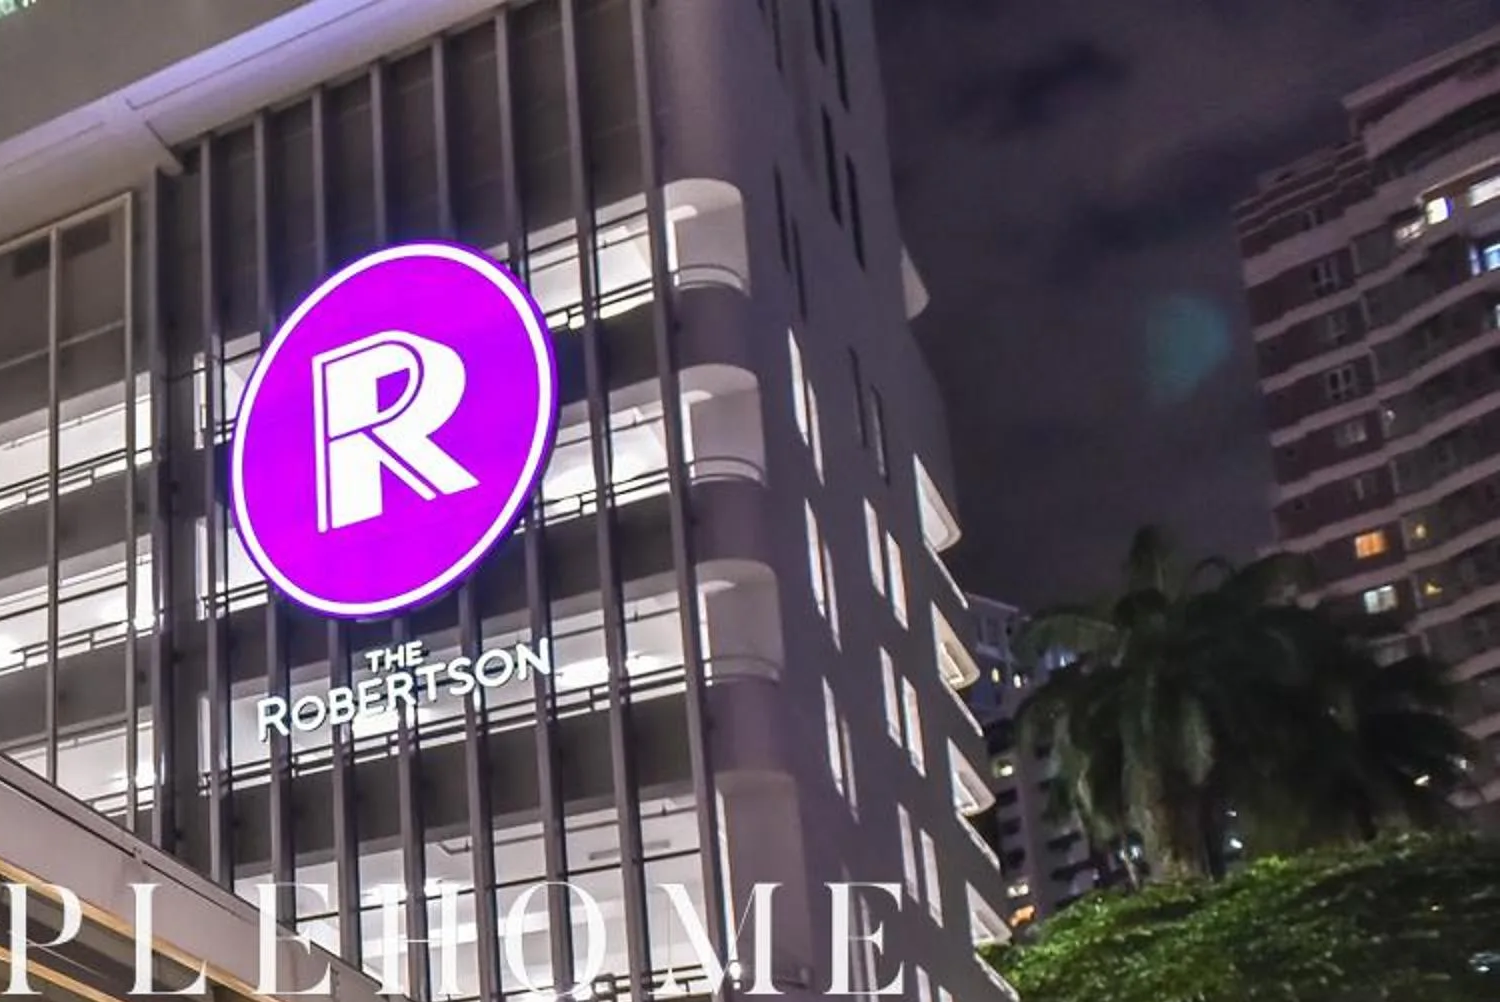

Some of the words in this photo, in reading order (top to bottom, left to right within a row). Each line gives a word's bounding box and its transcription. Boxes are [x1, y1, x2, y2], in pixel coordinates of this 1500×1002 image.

[312, 329, 481, 533] R
[257, 637, 550, 742] ROBERTSON
[365, 640, 423, 673] THE
